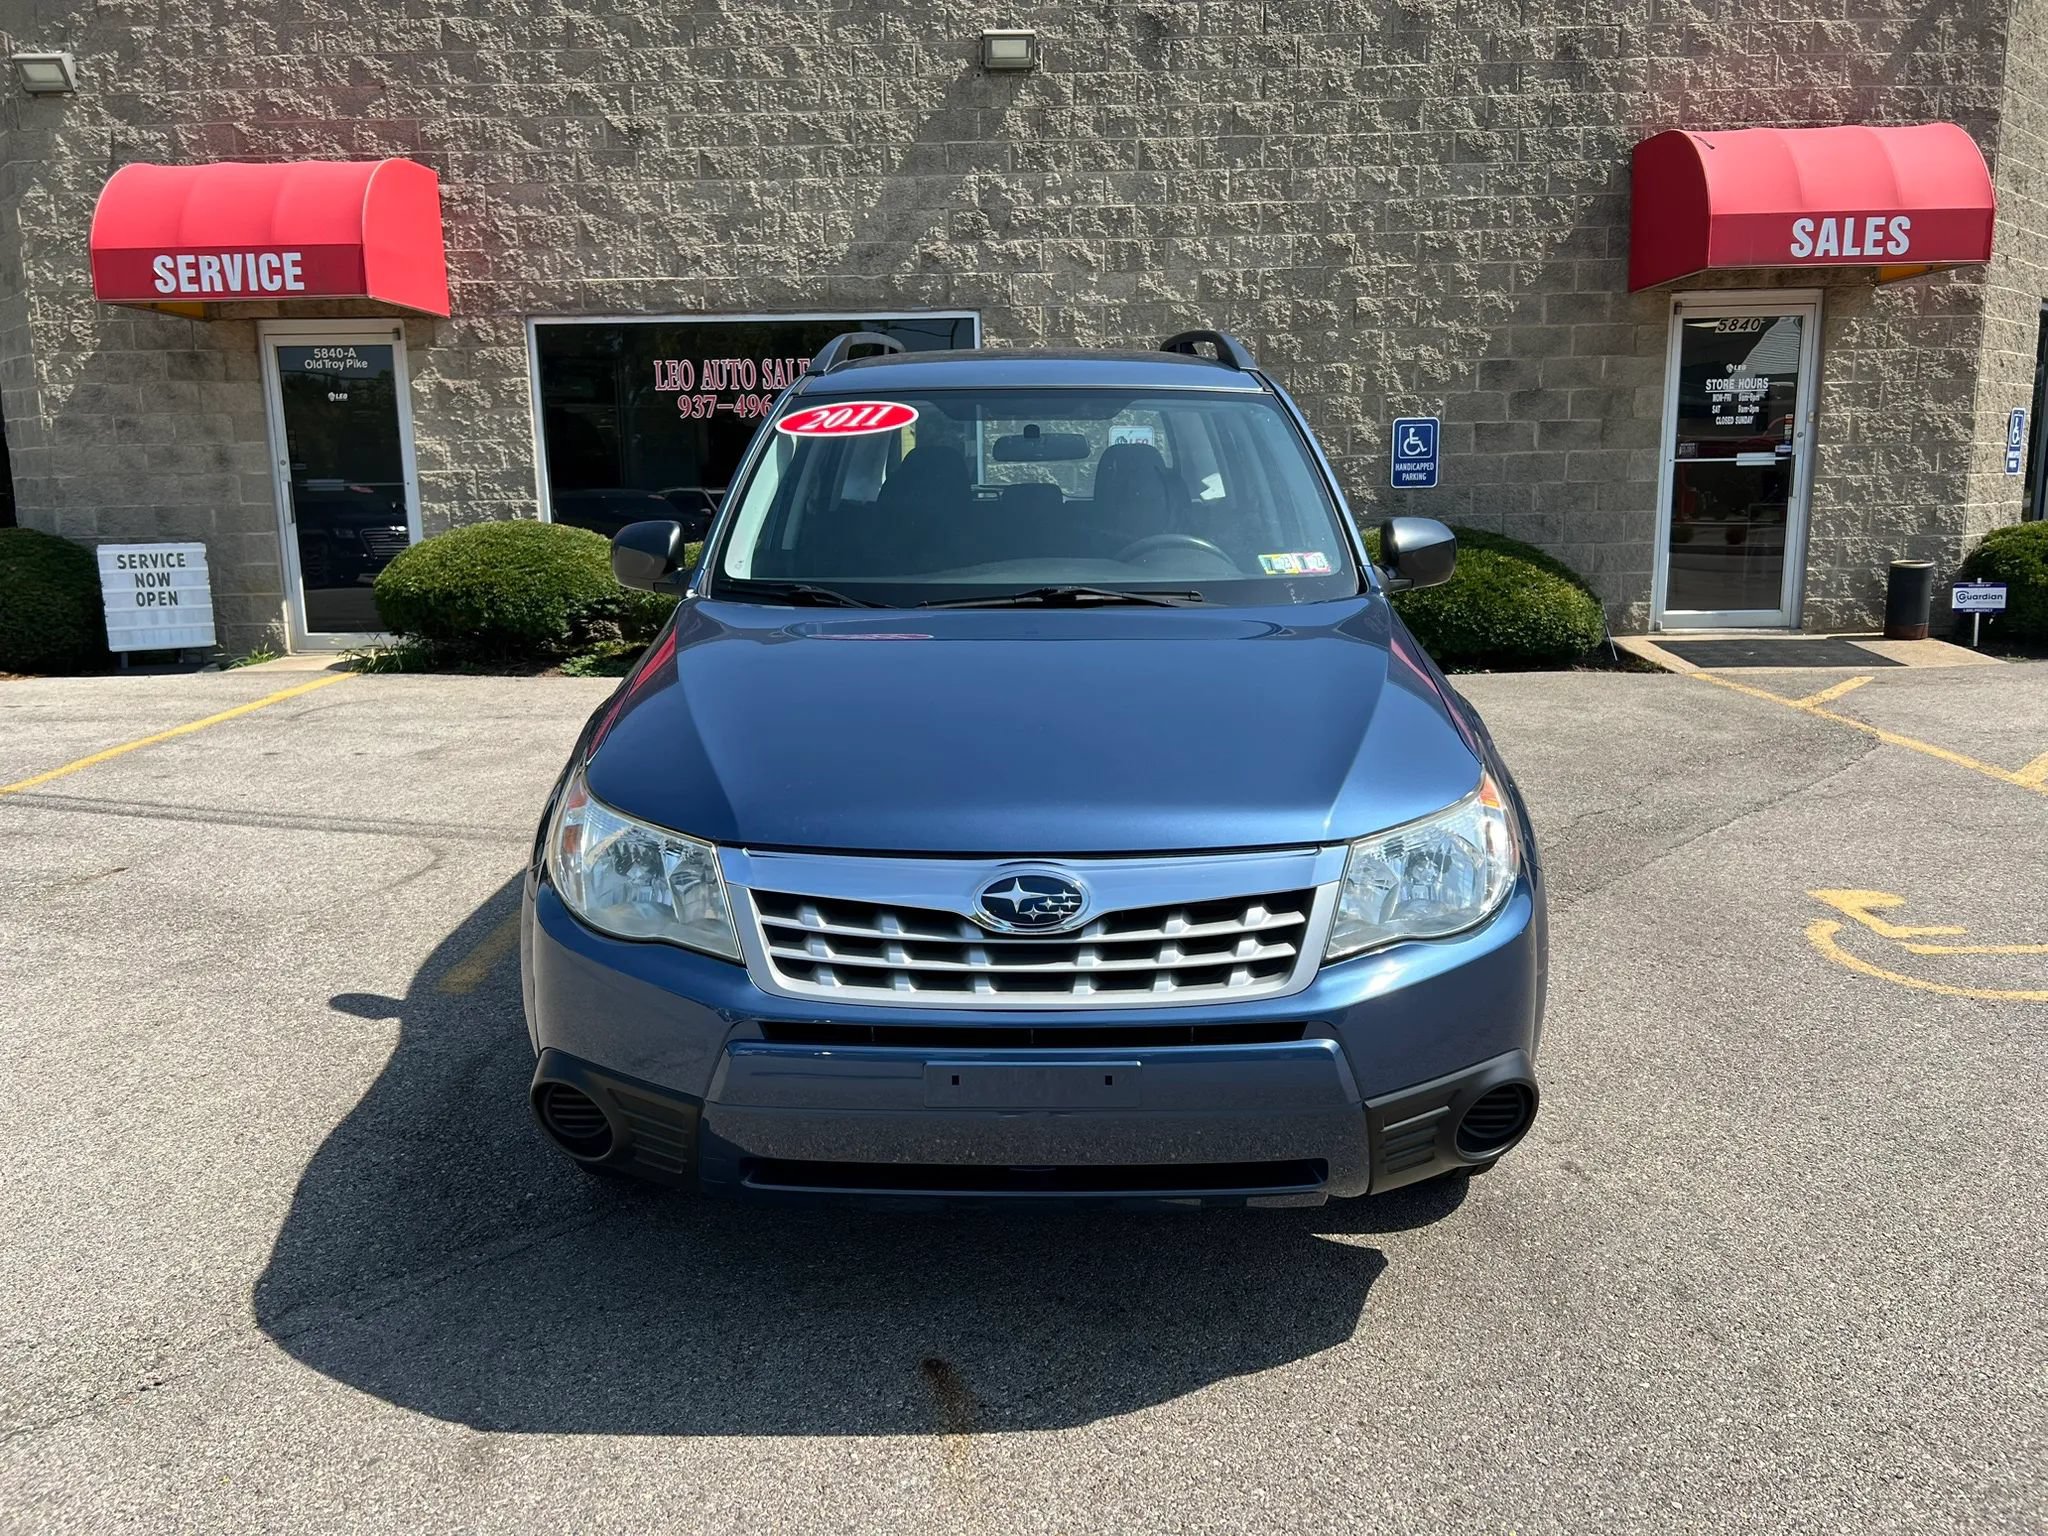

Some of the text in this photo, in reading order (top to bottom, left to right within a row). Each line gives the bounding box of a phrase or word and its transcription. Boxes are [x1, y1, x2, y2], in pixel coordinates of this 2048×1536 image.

[1790, 216, 1911, 258] SALES
[153, 252, 305, 294] SERVICE
[1717, 318, 1761, 331] 5840
[313, 347, 357, 359] 5840-A
[304, 359, 368, 371] Old Troy Pike
[653, 358, 814, 391] LEO AUTO SAL
[1705, 378, 1769, 390] STORE HOURS
[1711, 405, 1721, 414] SAT
[797, 405, 894, 431] 2011
[1715, 416, 1754, 425] CLOSED SUNDAY
[1395, 462, 1435, 471] HANDICAPPED
[1402, 472, 1427, 481] PARKING
[116, 553, 186, 570] SERVICE
[134, 572, 170, 588] NOW
[136, 591, 178, 607] OPEN
[1957, 592, 2003, 602] Guardian
